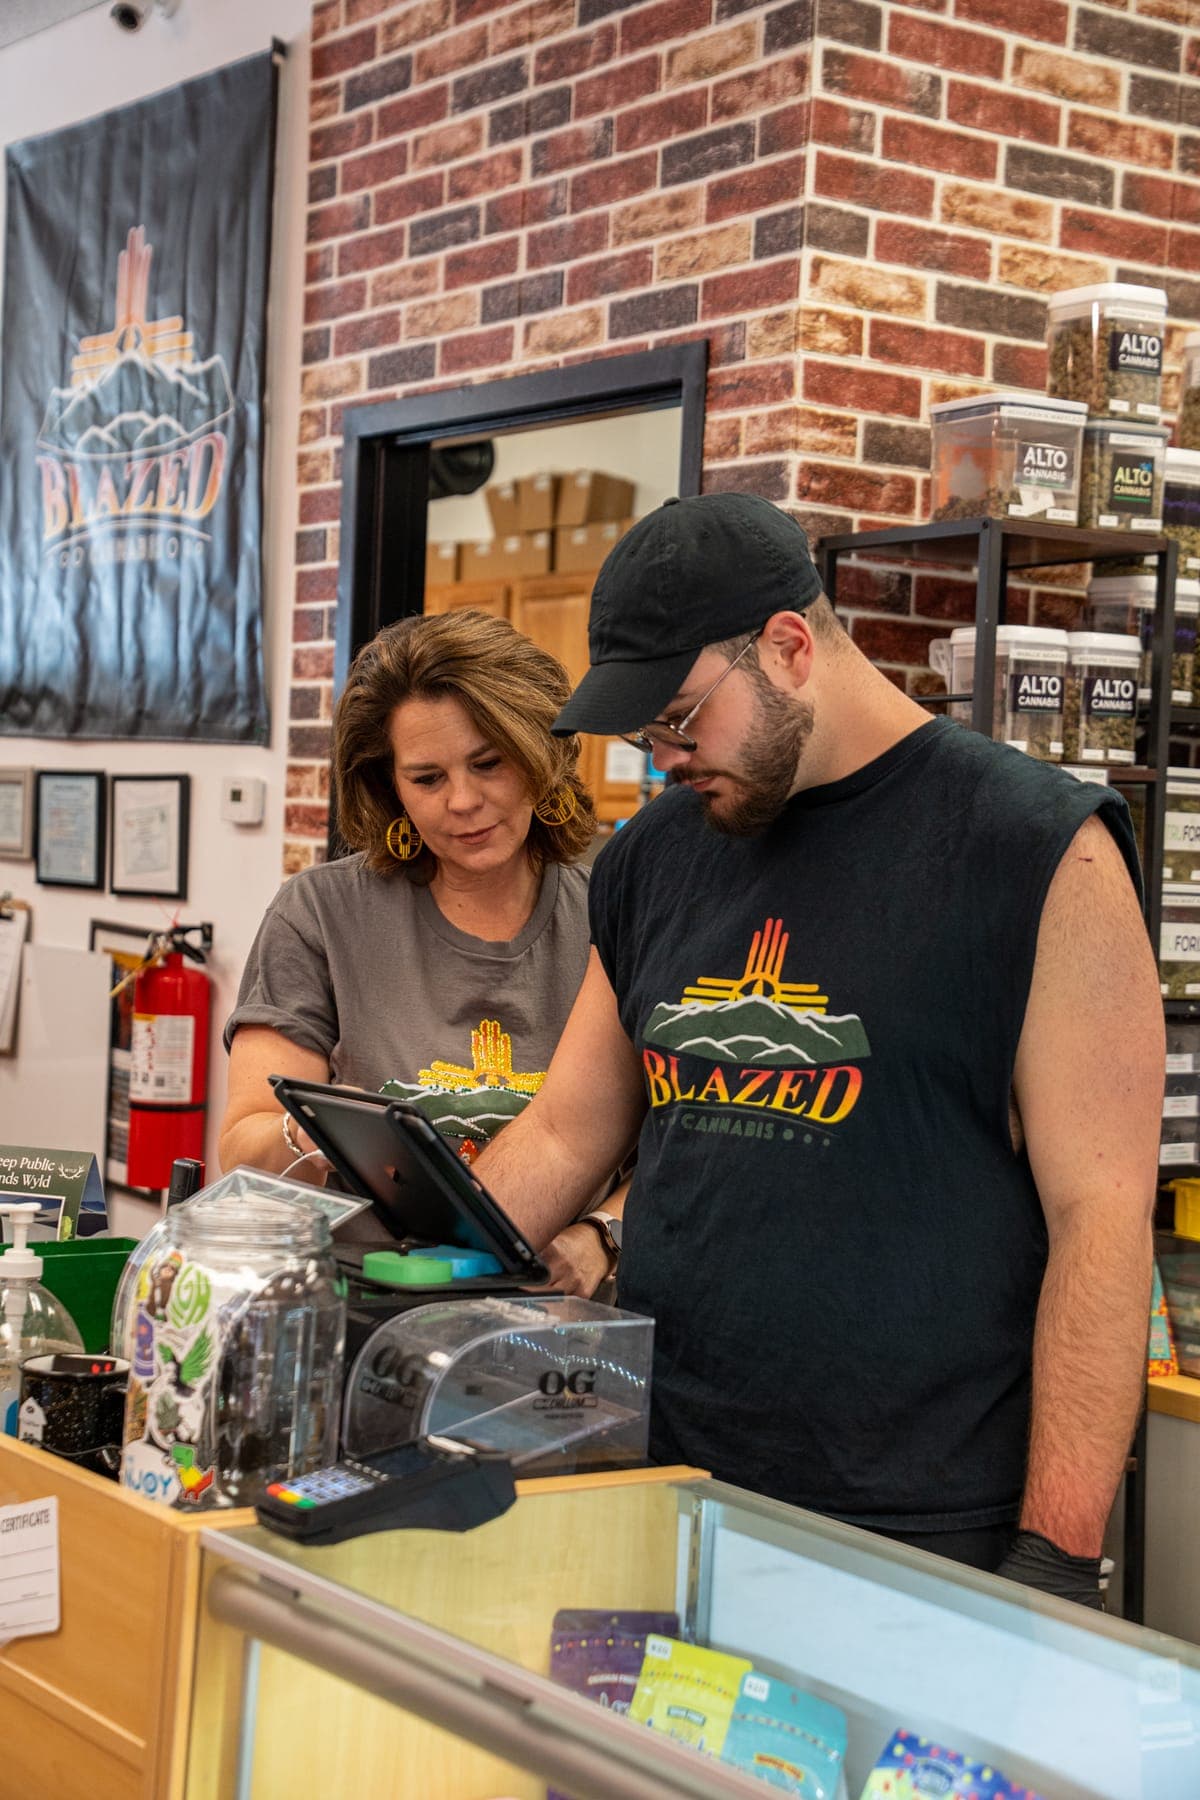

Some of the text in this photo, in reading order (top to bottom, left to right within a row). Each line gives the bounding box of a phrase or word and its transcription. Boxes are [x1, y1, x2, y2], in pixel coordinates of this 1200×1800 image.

[1119, 333, 1160, 356] ALTO
[1118, 354, 1160, 369] CANNABIS
[1023, 446, 1067, 470] ALTO
[1023, 467, 1067, 482] CANNABIS
[1114, 466, 1152, 486] ALTO
[35, 432, 227, 541] BLAZED
[1113, 484, 1152, 497] CANNABIS
[1018, 675, 1061, 695] ALTO
[1091, 679, 1135, 699] ALTO
[1018, 695, 1060, 708] CANNABIS
[1091, 698, 1134, 711] CANNABIS
[643, 1048, 863, 1124] BLAZED
[681, 1113, 775, 1140] CANNABIS
[20, 1157, 56, 1172] Public
[0, 1171, 52, 1190] nds Wyld
[538, 1369, 597, 1396] OG
[1, 1507, 51, 1534] CERTIFICATE
